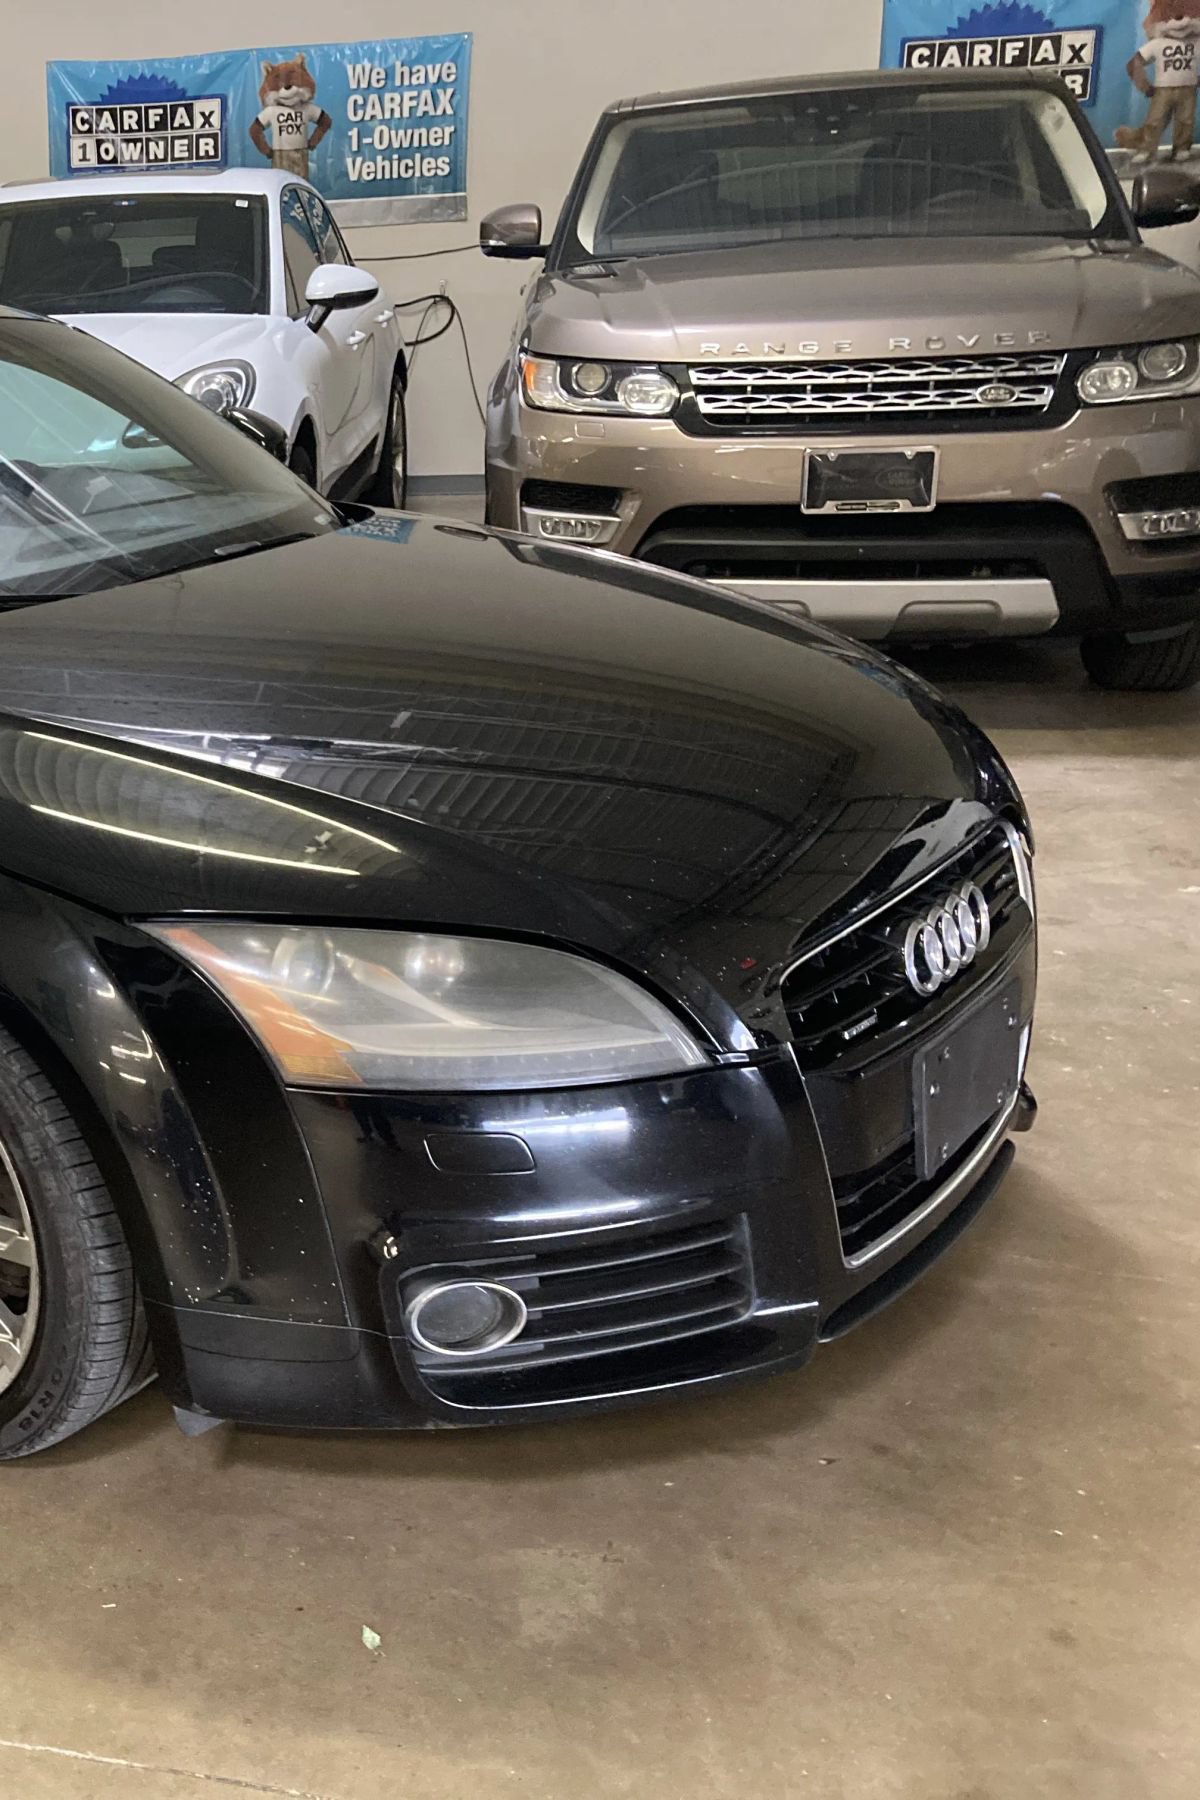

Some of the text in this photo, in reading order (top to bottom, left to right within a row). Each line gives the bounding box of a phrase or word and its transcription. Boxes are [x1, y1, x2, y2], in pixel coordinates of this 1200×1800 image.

[911, 39, 1088, 68] CARFAX
[1162, 43, 1194, 58] CAR
[346, 61, 457, 89] We have
[1163, 58, 1192, 72] FOX
[277, 111, 303, 123] CAR
[346, 88, 455, 122] CARFAX
[75, 106, 215, 132] CARFAX
[278, 123, 302, 136] FOX
[348, 125, 455, 152] 1-Owner
[346, 153, 451, 181] Vehicles
[699, 330, 1051, 355] RANGE ROVER
